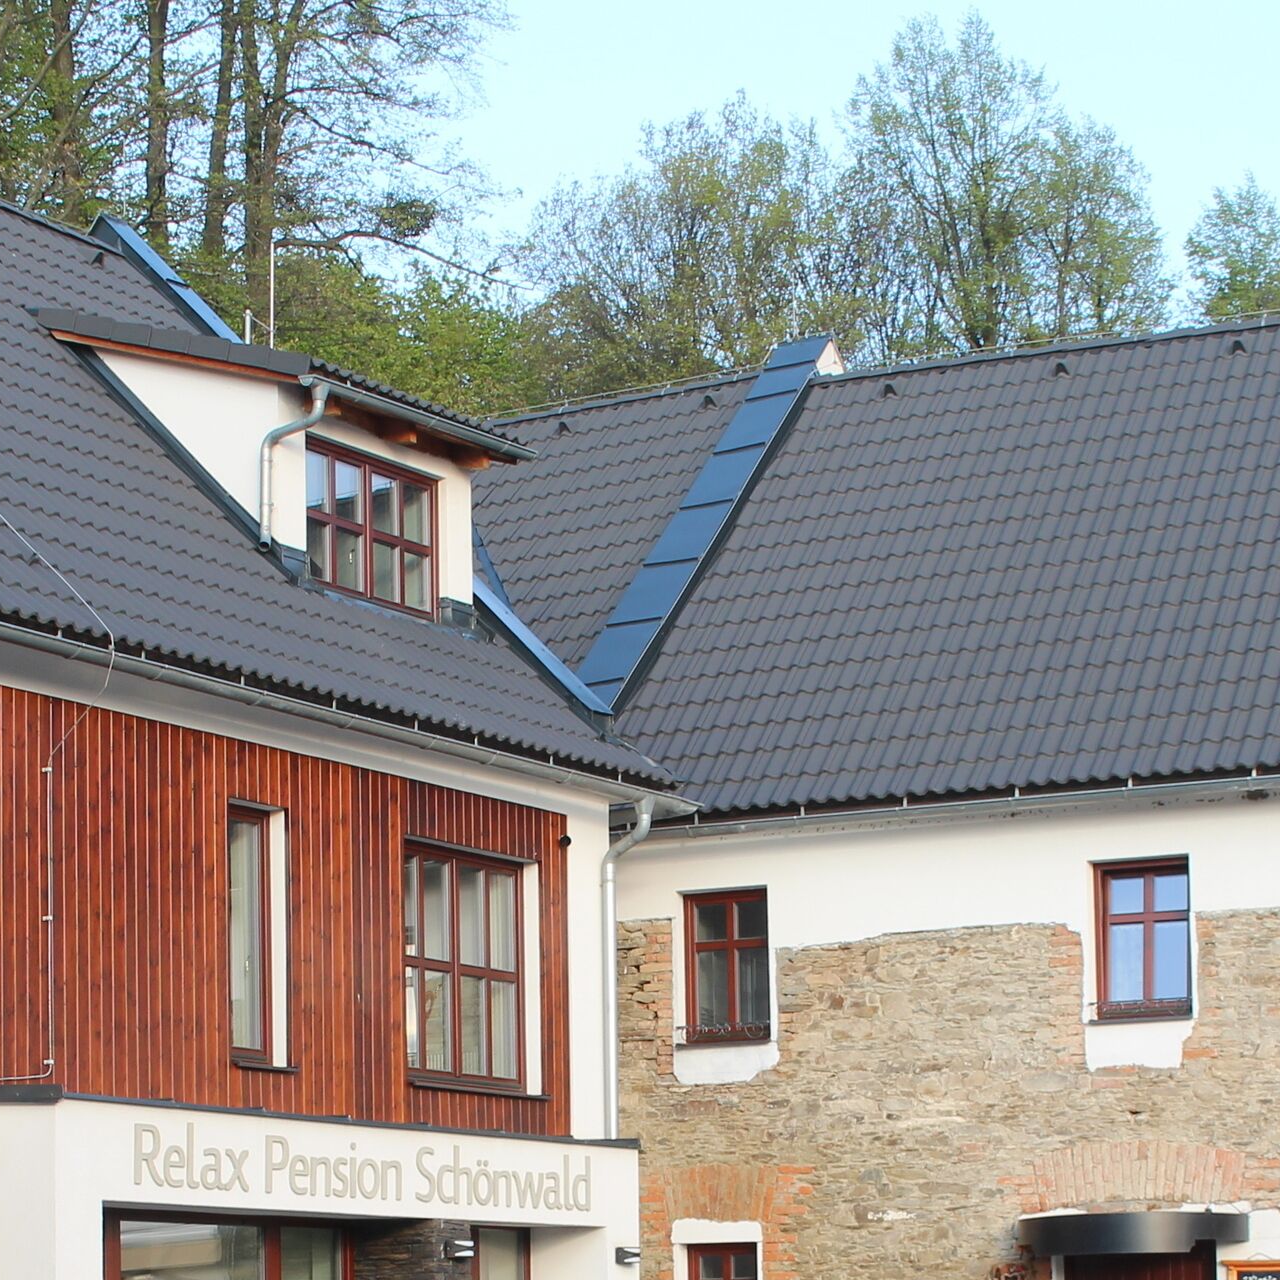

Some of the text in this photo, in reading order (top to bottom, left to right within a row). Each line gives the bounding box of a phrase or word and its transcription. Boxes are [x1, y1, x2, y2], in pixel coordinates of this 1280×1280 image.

[132, 1122, 592, 1212] Relax Pension Schönwald
